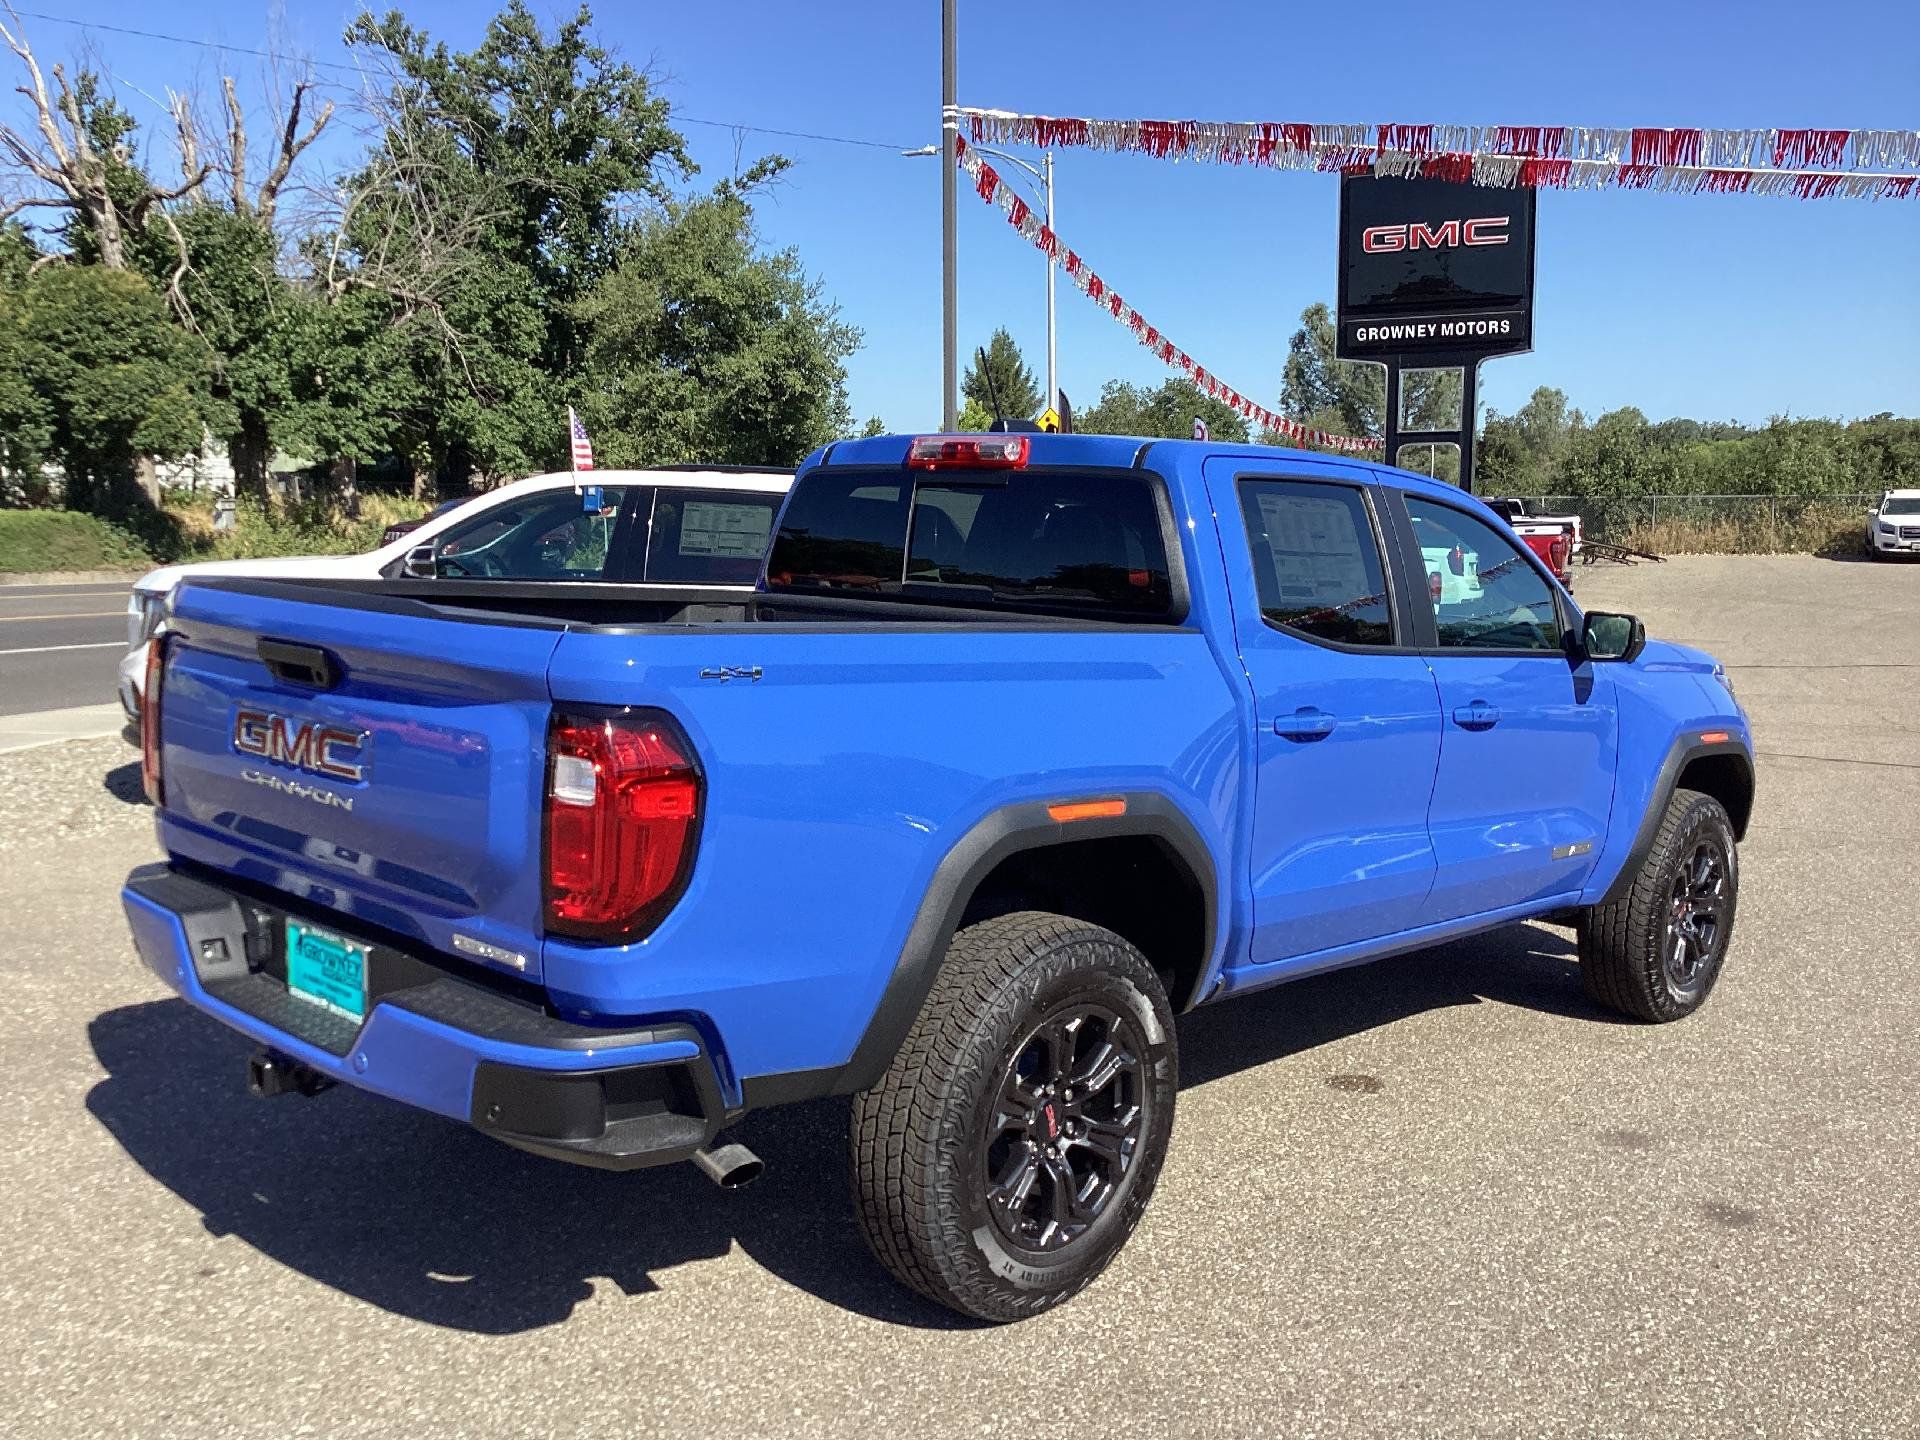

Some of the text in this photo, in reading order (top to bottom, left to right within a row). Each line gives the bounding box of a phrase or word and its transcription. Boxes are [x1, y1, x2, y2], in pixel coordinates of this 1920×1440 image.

[1362, 216, 1510, 253] GMC
[1356, 320, 1510, 342] GROWNEY MOTORS
[235, 710, 365, 781] GMC
[240, 770, 353, 811] CANYON
